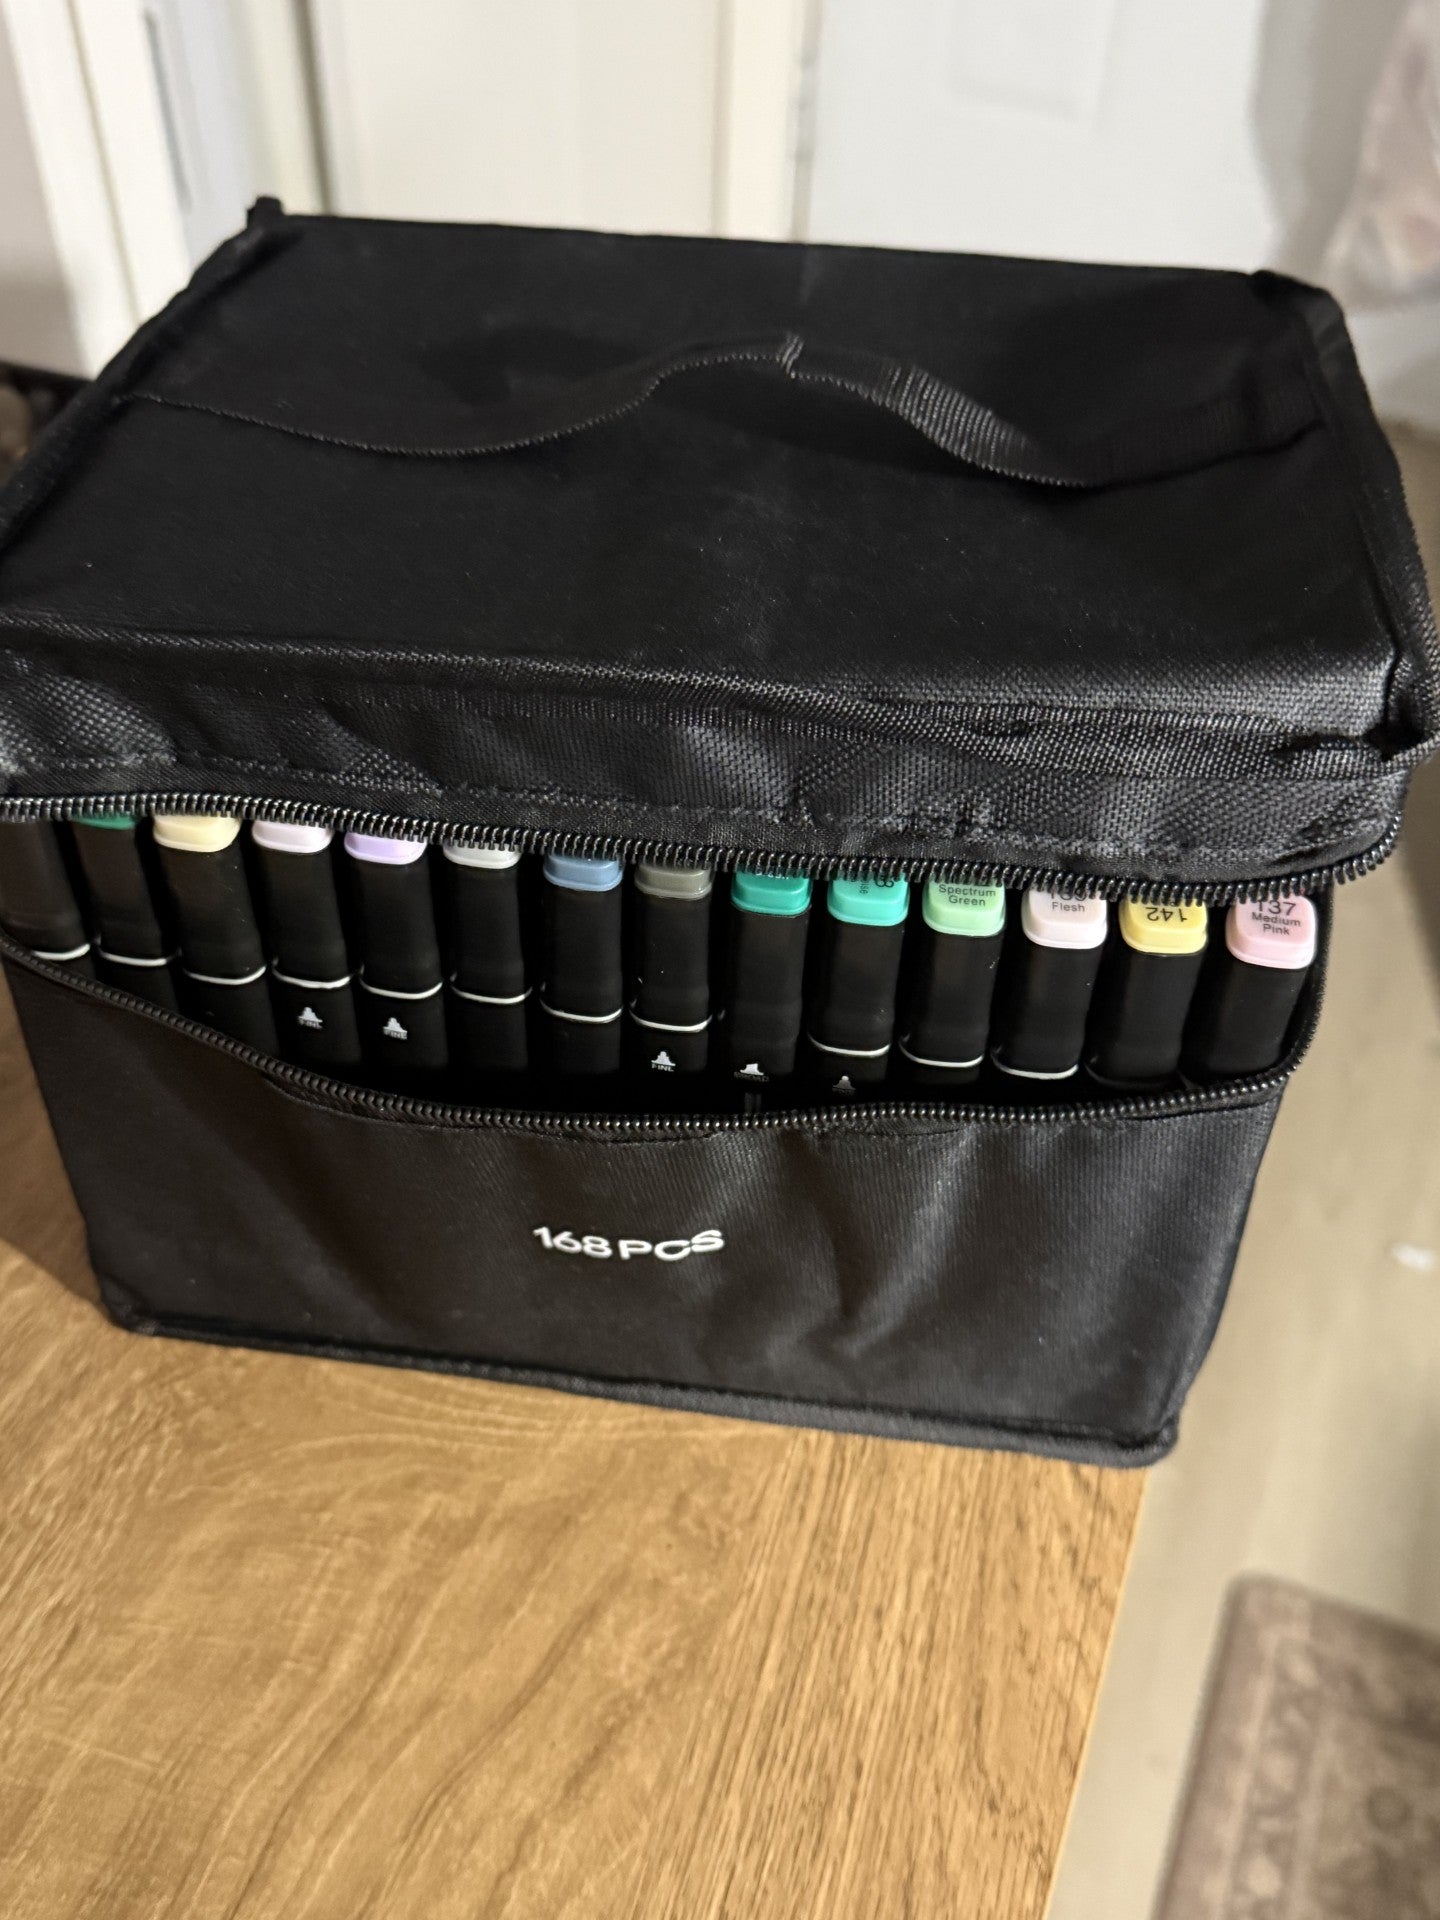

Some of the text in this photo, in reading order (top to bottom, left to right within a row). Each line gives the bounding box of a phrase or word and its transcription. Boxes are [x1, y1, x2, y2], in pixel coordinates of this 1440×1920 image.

[938, 884, 996, 897] Spectrum
[948, 895, 986, 907] Green
[1051, 901, 1085, 913] Flesh
[1145, 906, 1187, 922] 142
[1251, 911, 1301, 927] Medium
[1262, 923, 1290, 935] Pink
[533, 1226, 725, 1261] 168 PCS
